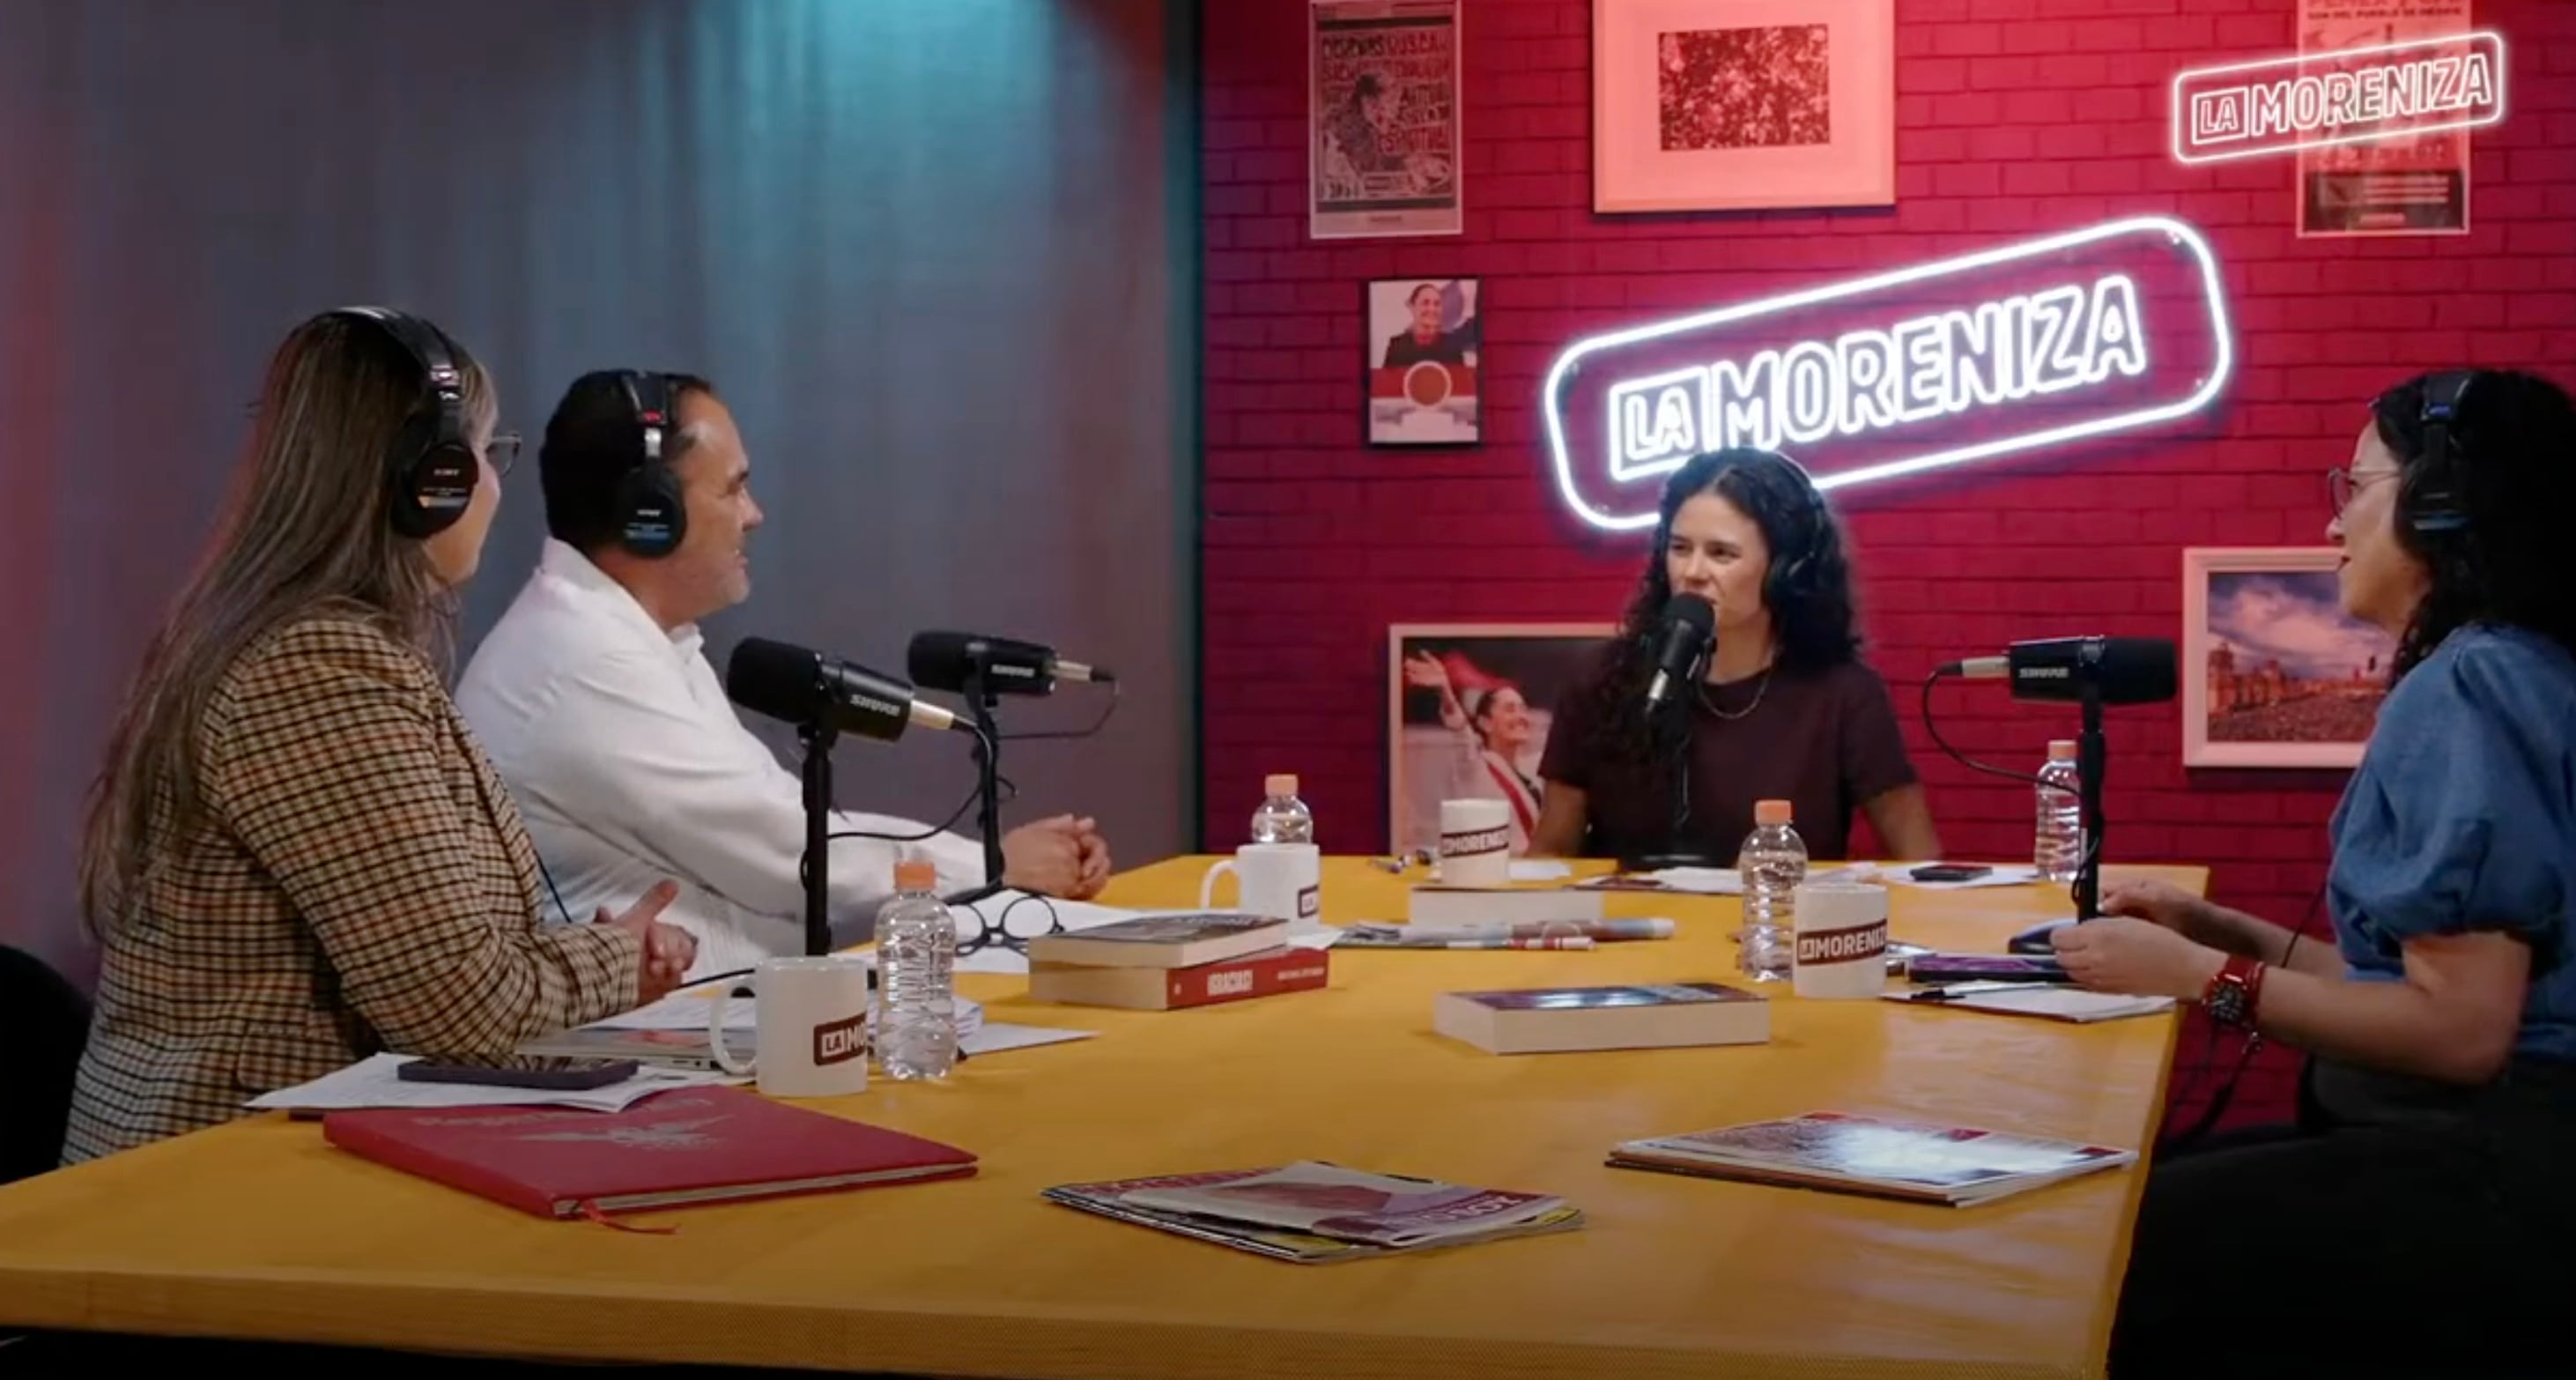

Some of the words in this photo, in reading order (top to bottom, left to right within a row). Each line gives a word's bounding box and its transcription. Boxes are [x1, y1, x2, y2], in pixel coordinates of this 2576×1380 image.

[1624, 386, 1694, 461] LA
[1704, 274, 2146, 452] MORENIZA
[825, 1034, 843, 1052] LA
